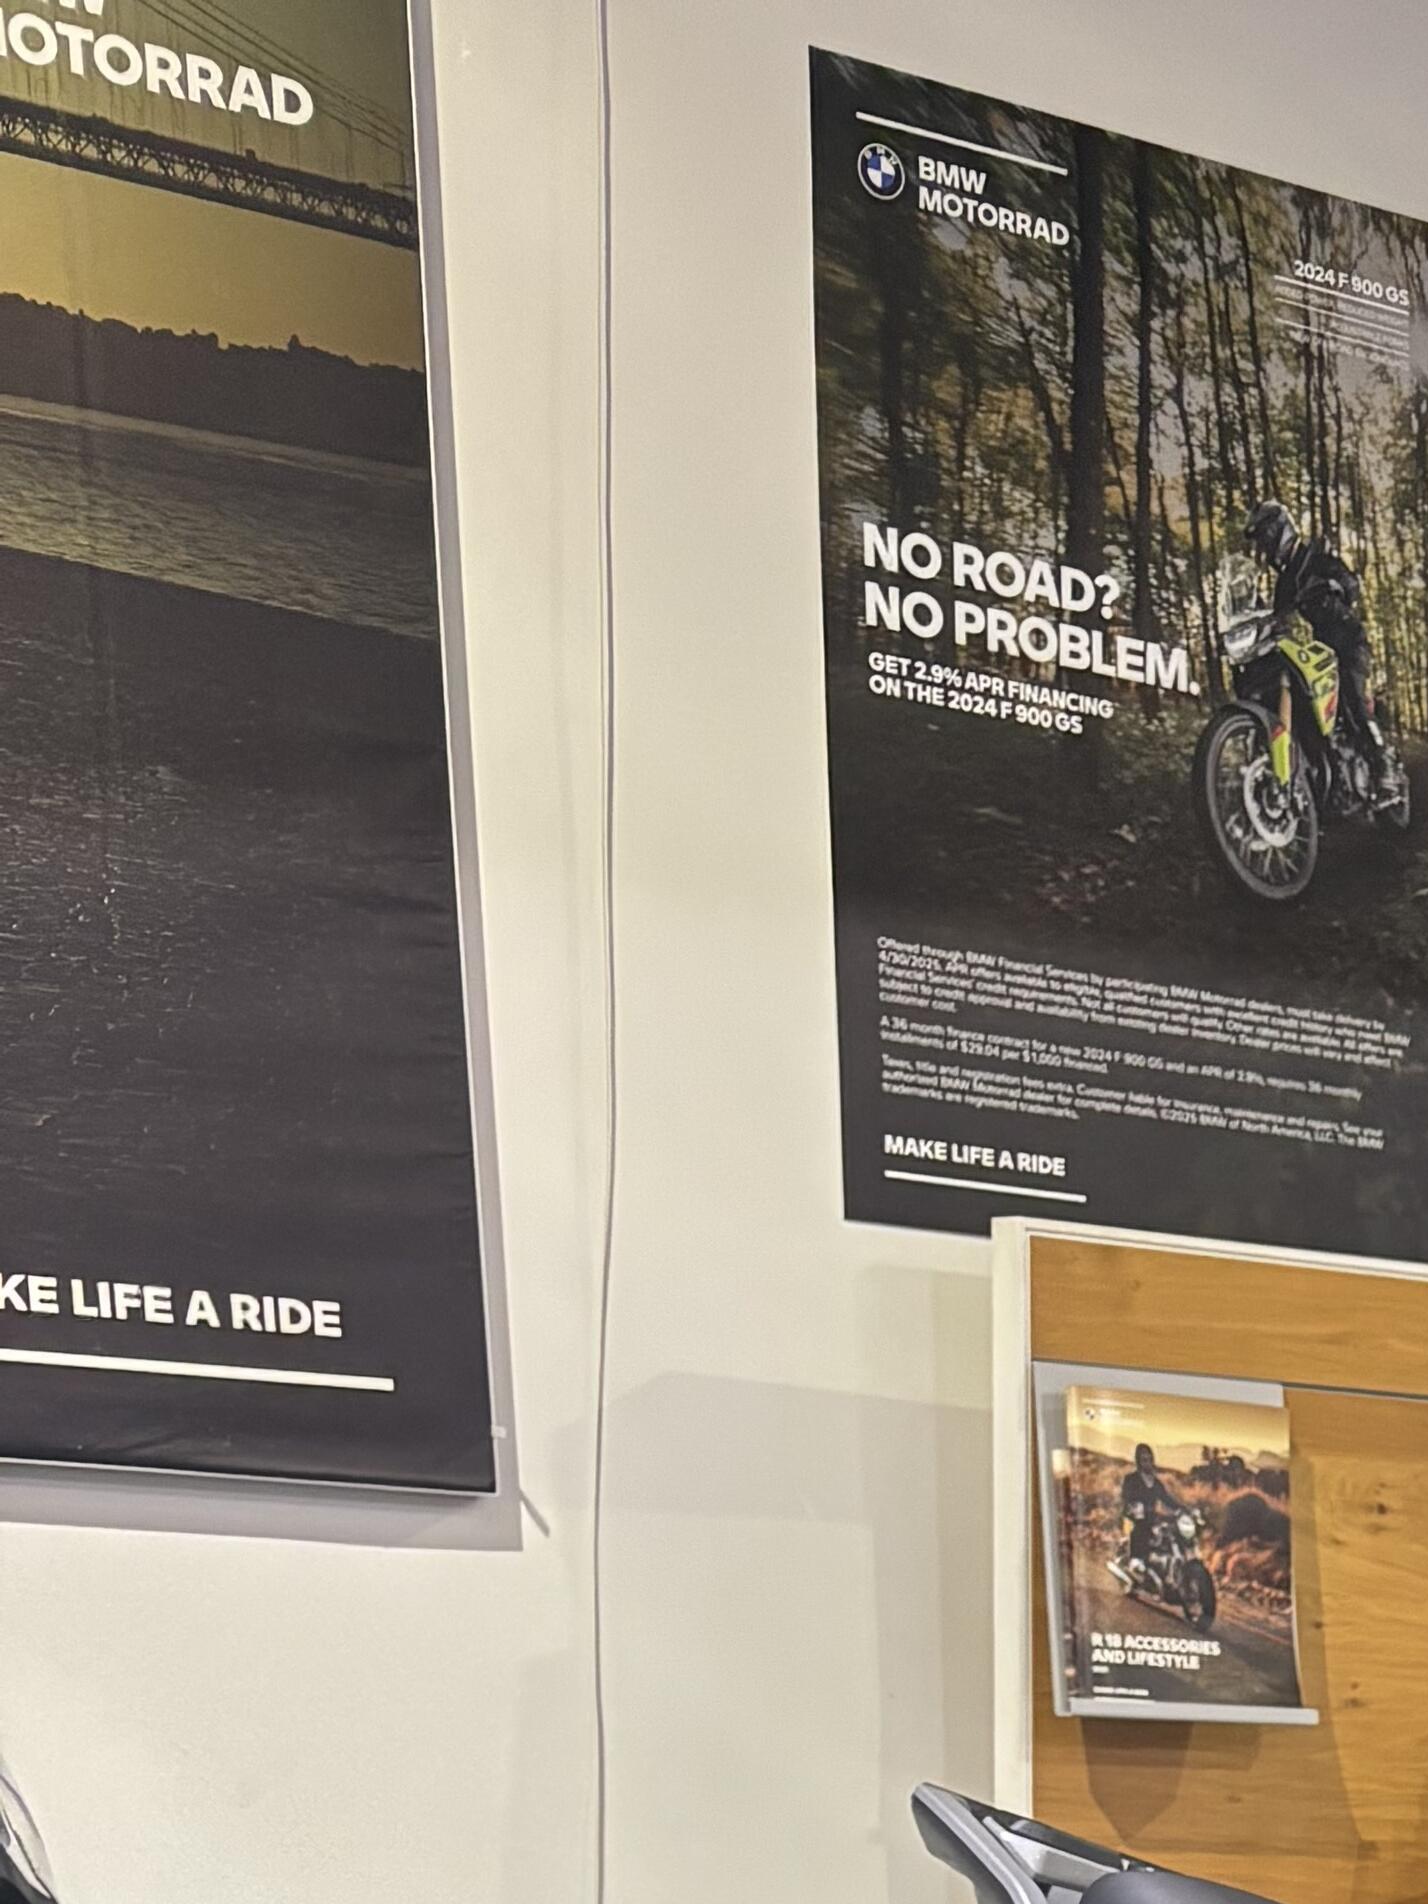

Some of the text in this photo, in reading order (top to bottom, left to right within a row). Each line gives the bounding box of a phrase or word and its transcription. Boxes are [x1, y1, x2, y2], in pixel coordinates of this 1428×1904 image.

[0, 8, 314, 126] OTORRAD
[918, 155, 987, 195] BMW
[918, 186, 1070, 246] MOTORRAD
[1294, 260, 1336, 286] 2024
[1338, 272, 1349, 288] F
[1351, 276, 1383, 299] 900
[1385, 287, 1410, 306] GS
[863, 522, 1120, 620] NO ROAD?
[864, 581, 1200, 696] NO PROBLEM.
[868, 652, 1115, 719] GET 2.9% APR FINANCING
[869, 675, 1083, 734] ON THE 2024 F 900 GS
[884, 1134, 1066, 1177] MAKE LIFE A RIDE
[71, 1278, 174, 1324] LIFE
[185, 1290, 220, 1328] A
[230, 1293, 342, 1338] RIDE
[1091, 1632, 1221, 1656] R 18 ACCESSORIES
[1092, 1649, 1126, 1663] AND
[1127, 1652, 1200, 1670] LIFESTYLE
